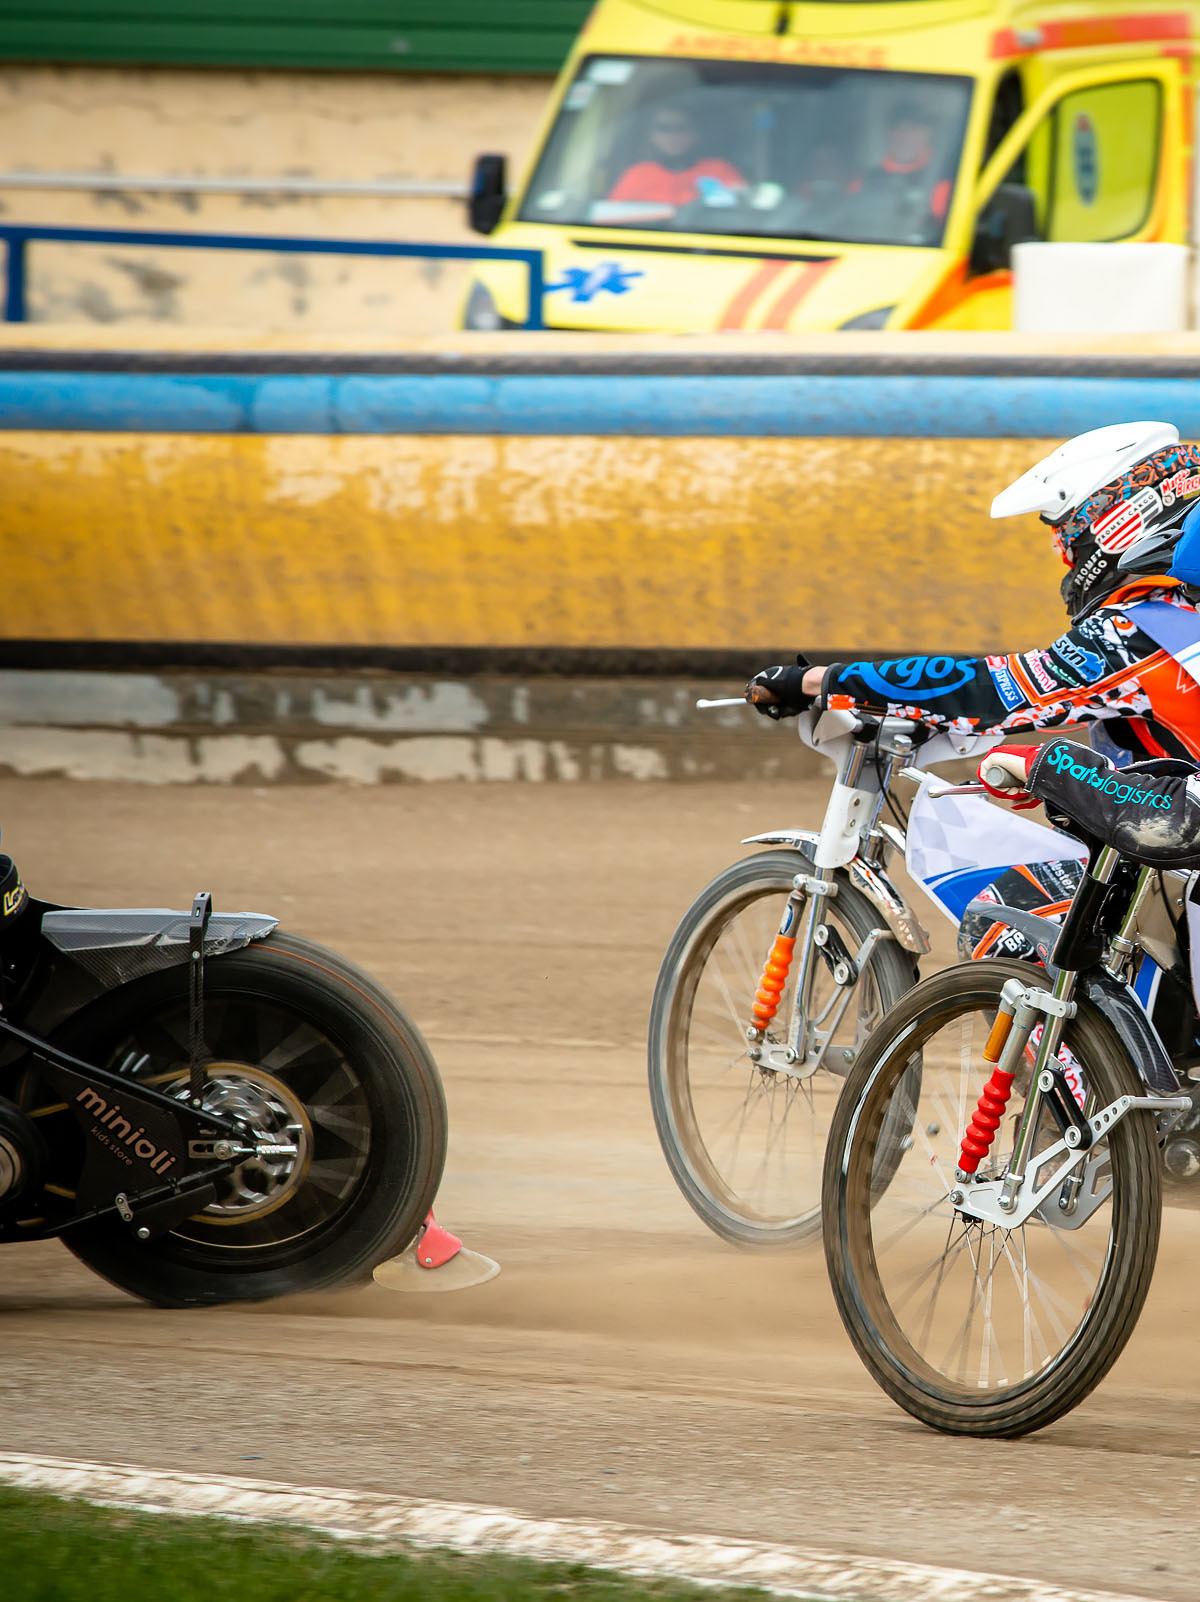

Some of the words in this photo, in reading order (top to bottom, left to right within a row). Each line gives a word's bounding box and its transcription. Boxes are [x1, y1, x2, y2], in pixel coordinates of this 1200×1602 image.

[1127, 493, 1155, 516] CARGO
[1073, 547, 1103, 586] PROMET
[1083, 559, 1109, 592] CARGO
[837, 655, 979, 701] Argos
[76, 1087, 177, 1175] minioli
[91, 1125, 111, 1146] kids
[108, 1143, 134, 1167] store
